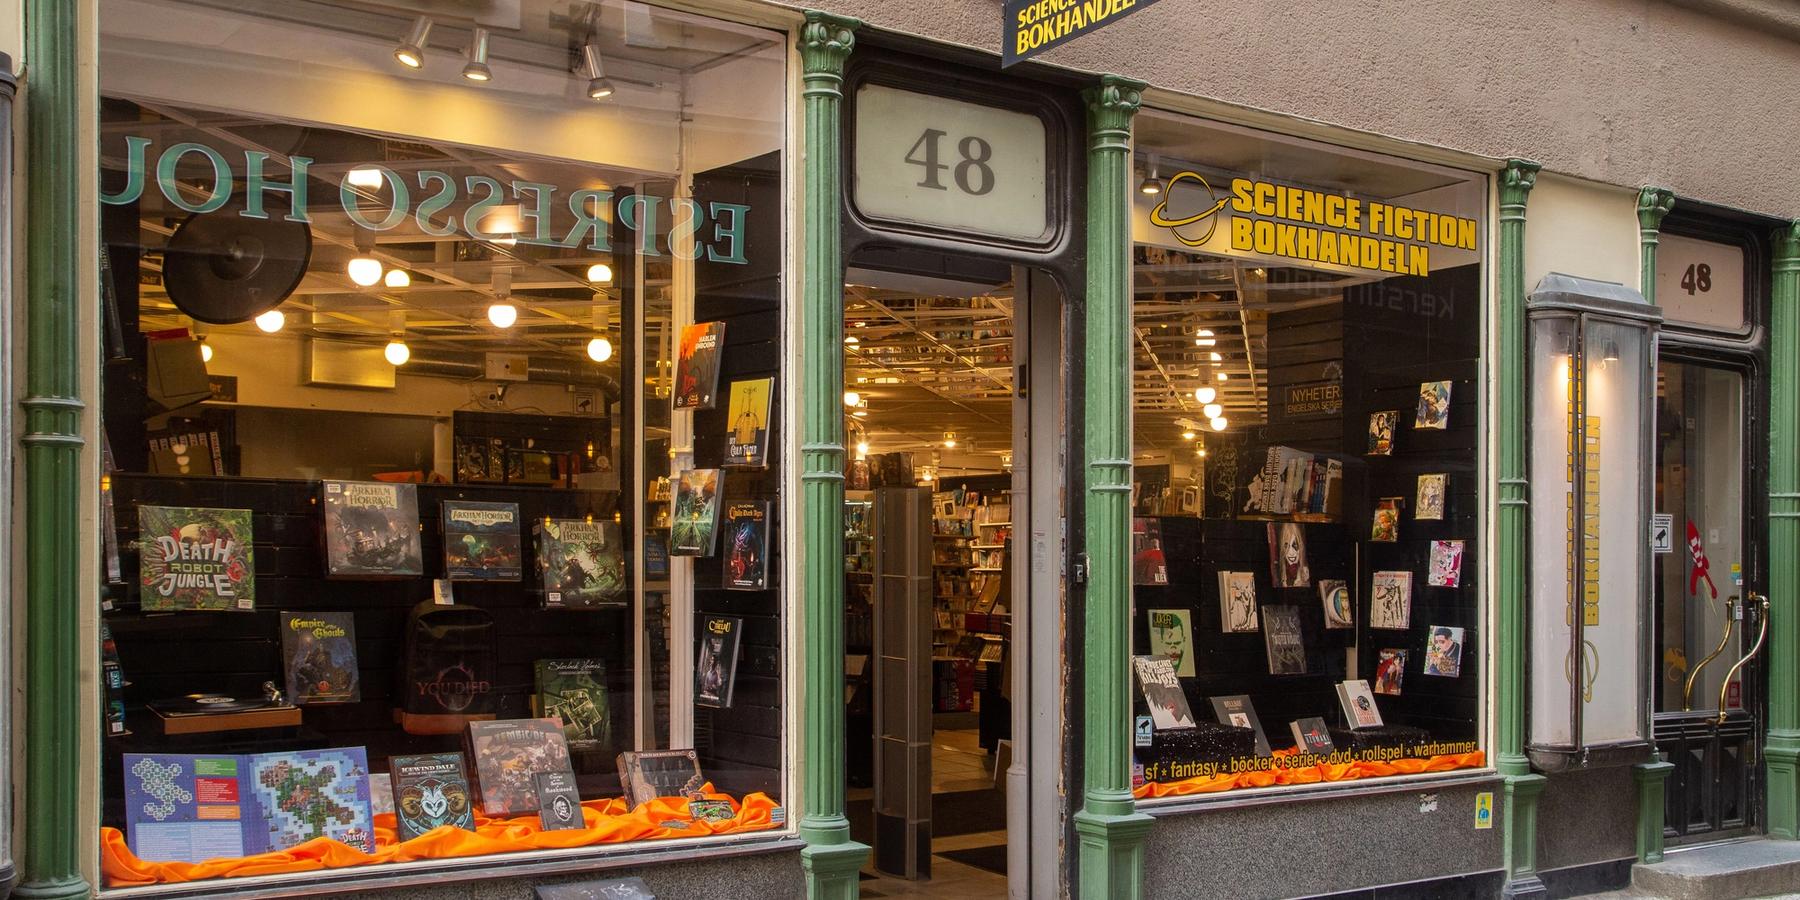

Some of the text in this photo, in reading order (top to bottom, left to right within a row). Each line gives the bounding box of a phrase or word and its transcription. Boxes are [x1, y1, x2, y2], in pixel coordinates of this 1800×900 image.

[904, 128, 995, 196] 48
[1230, 177, 1477, 251] SCIENCE FICTION
[1230, 216, 1429, 278] BOKHANDELN
[1680, 263, 1712, 296] 48
[1292, 385, 1340, 403] NYHETER
[351, 485, 391, 496] ARKHAM
[350, 494, 393, 506] HORROR
[452, 510, 482, 520] ARKHAM
[482, 511, 512, 522] HORROR
[564, 522, 598, 533] ARKHAM
[562, 531, 599, 541] HORROR
[158, 535, 234, 563] DEATH
[170, 563, 223, 573] ROBOT
[159, 573, 234, 597] JUNGLE
[416, 680, 490, 695] YOU DIED
[401, 764, 435, 773] ICEWIND
[1144, 762, 1158, 781] sf
[1171, 761, 1218, 780] fantasy
[1231, 754, 1274, 773] böcker
[1284, 752, 1319, 769] serier
[1329, 747, 1351, 765] dvd
[1362, 743, 1403, 763] rollspel
[1414, 741, 1476, 756] warhammer
